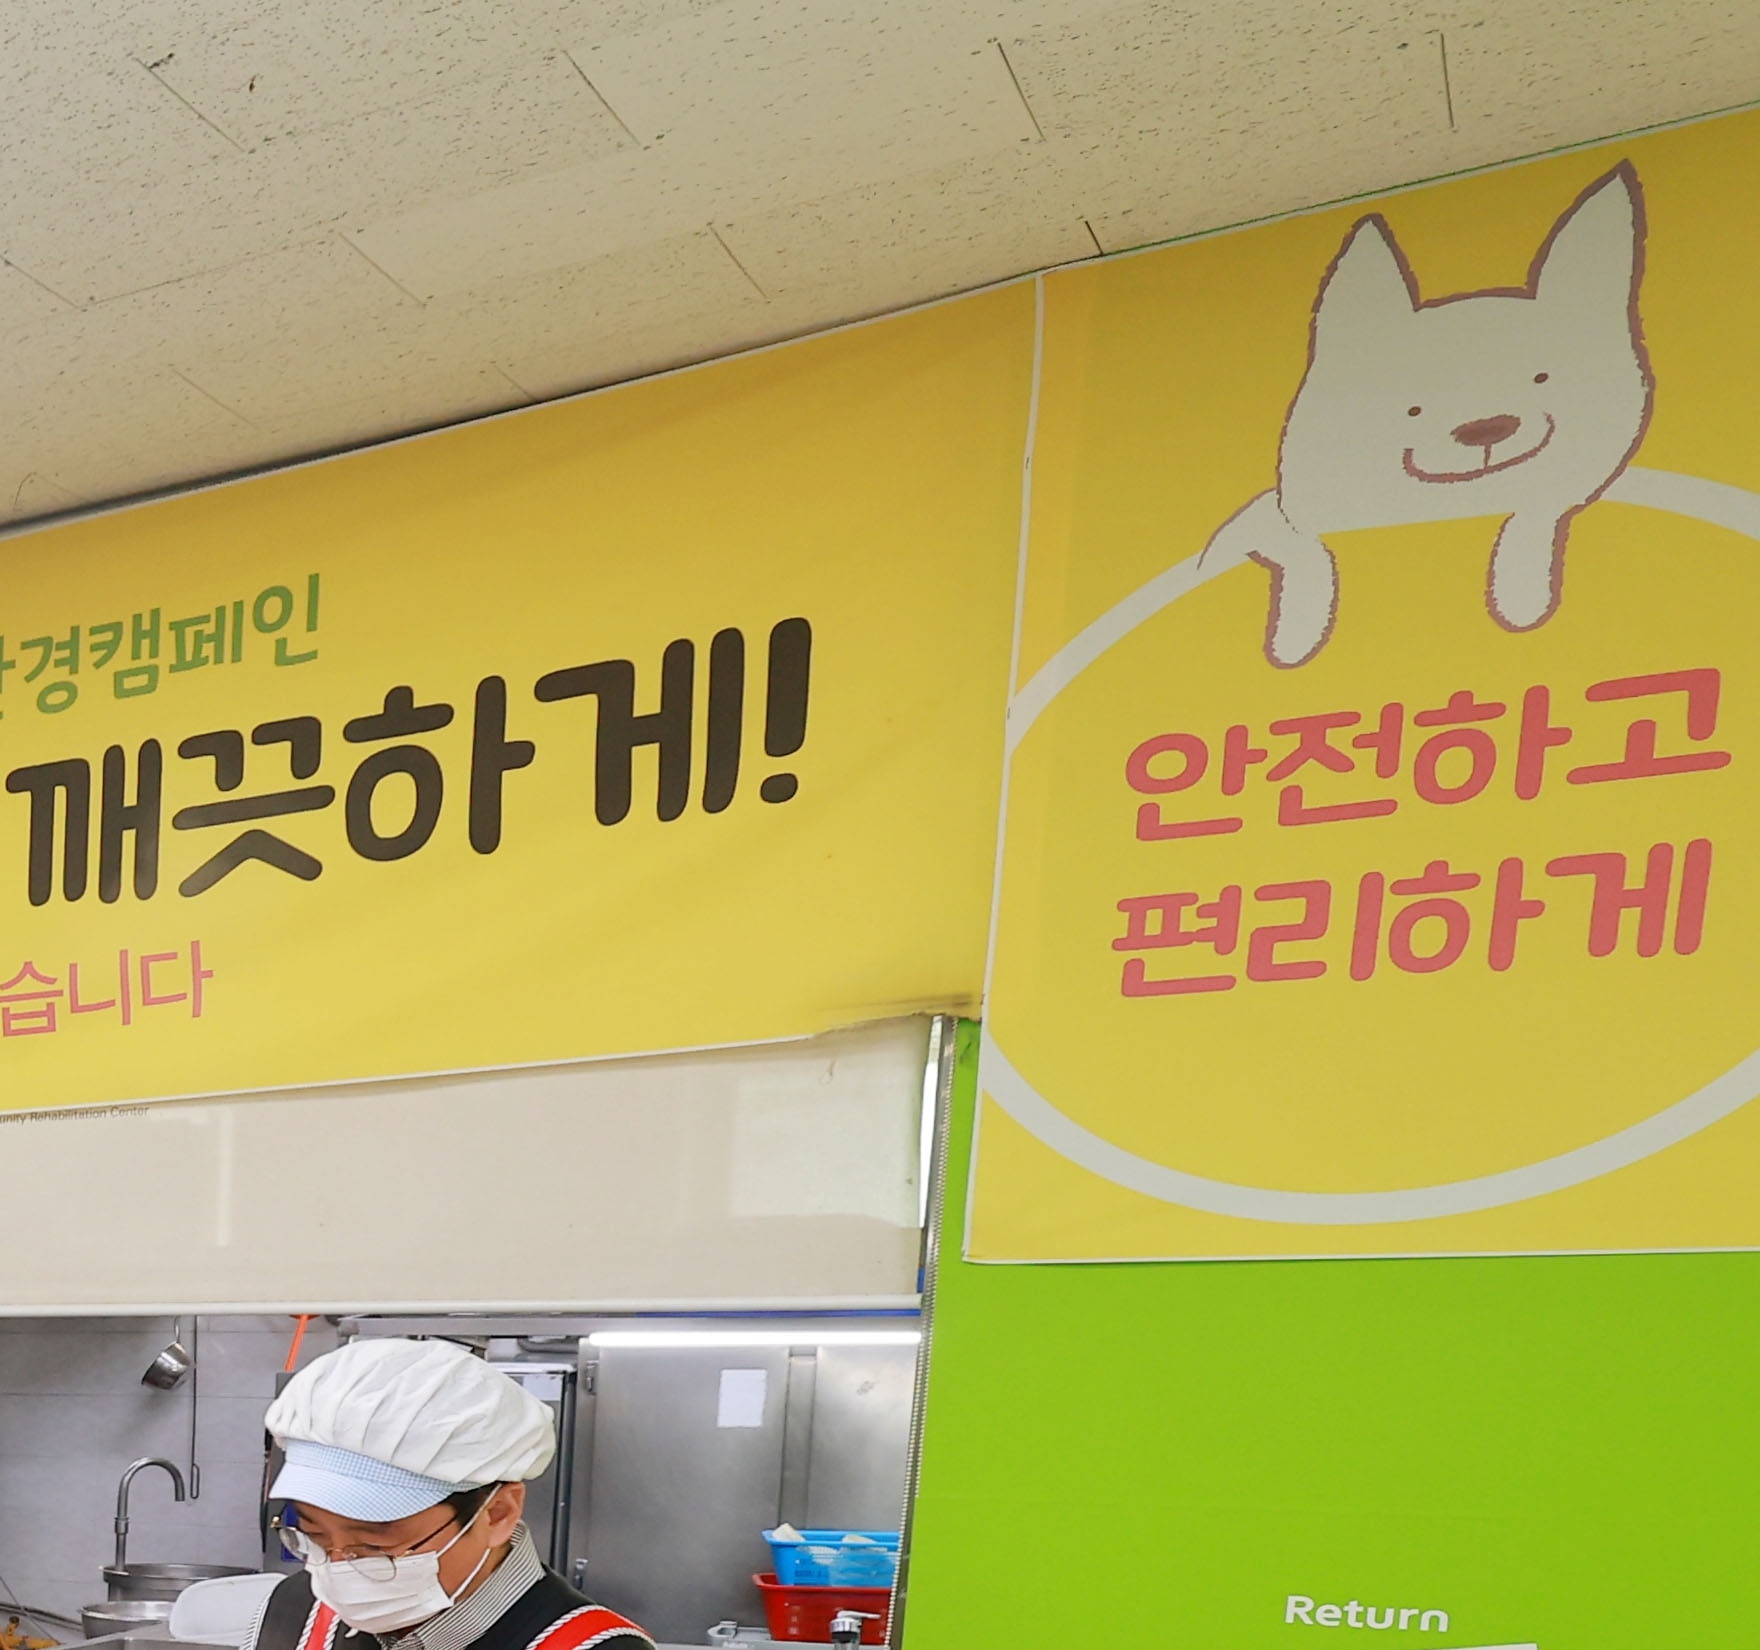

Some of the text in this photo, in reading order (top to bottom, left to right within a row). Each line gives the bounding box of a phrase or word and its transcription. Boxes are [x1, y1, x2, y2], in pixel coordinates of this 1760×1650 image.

[4, 616, 813, 907] 깨끗하게!
[1125, 667, 1732, 842] 안전하고
[1110, 837, 1713, 998] 편리하게
[1284, 1594, 1449, 1634] Return
